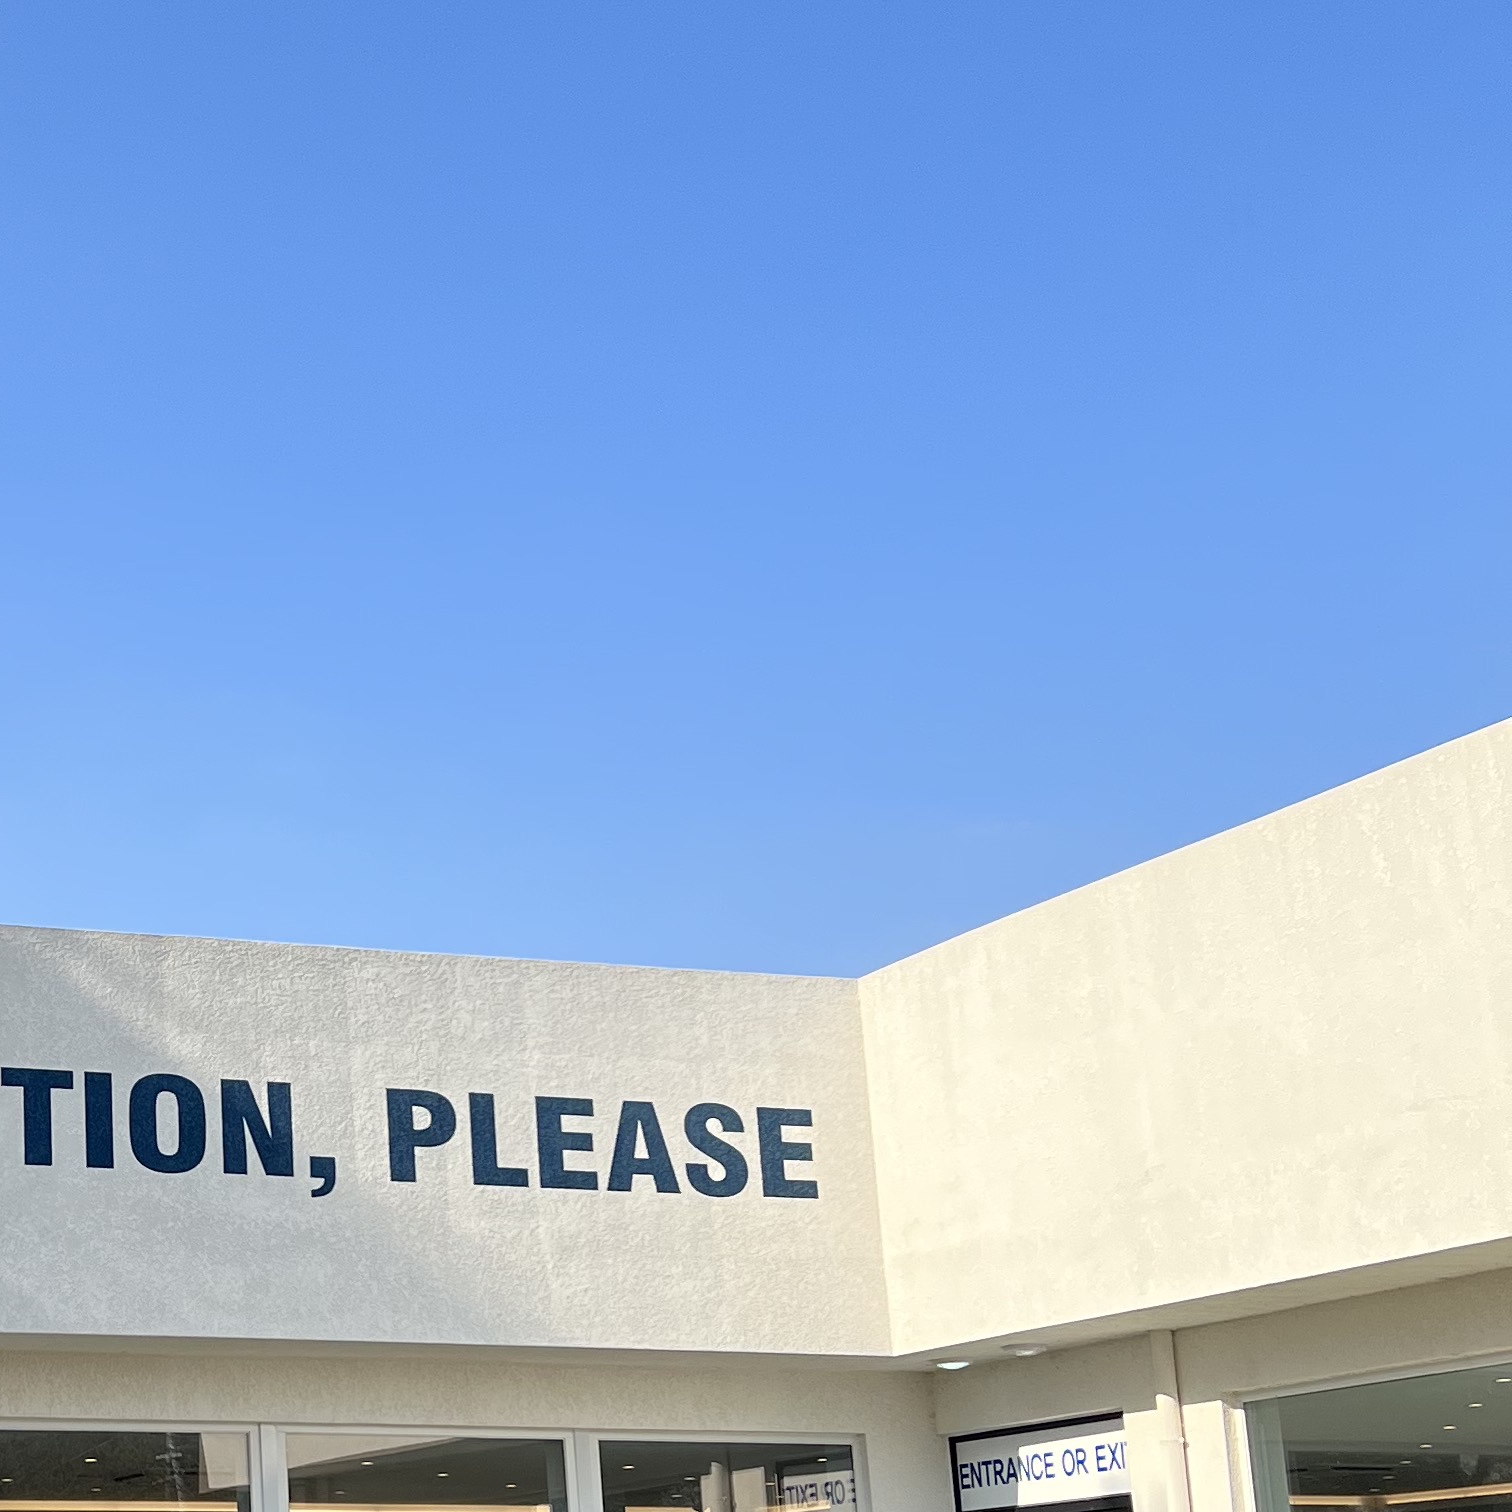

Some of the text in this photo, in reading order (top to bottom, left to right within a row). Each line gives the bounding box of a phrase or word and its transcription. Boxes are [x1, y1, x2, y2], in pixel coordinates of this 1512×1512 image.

[385, 1087, 819, 1200] PLEASE
[958, 1441, 1128, 1490] ENTRANCE OR EXI
